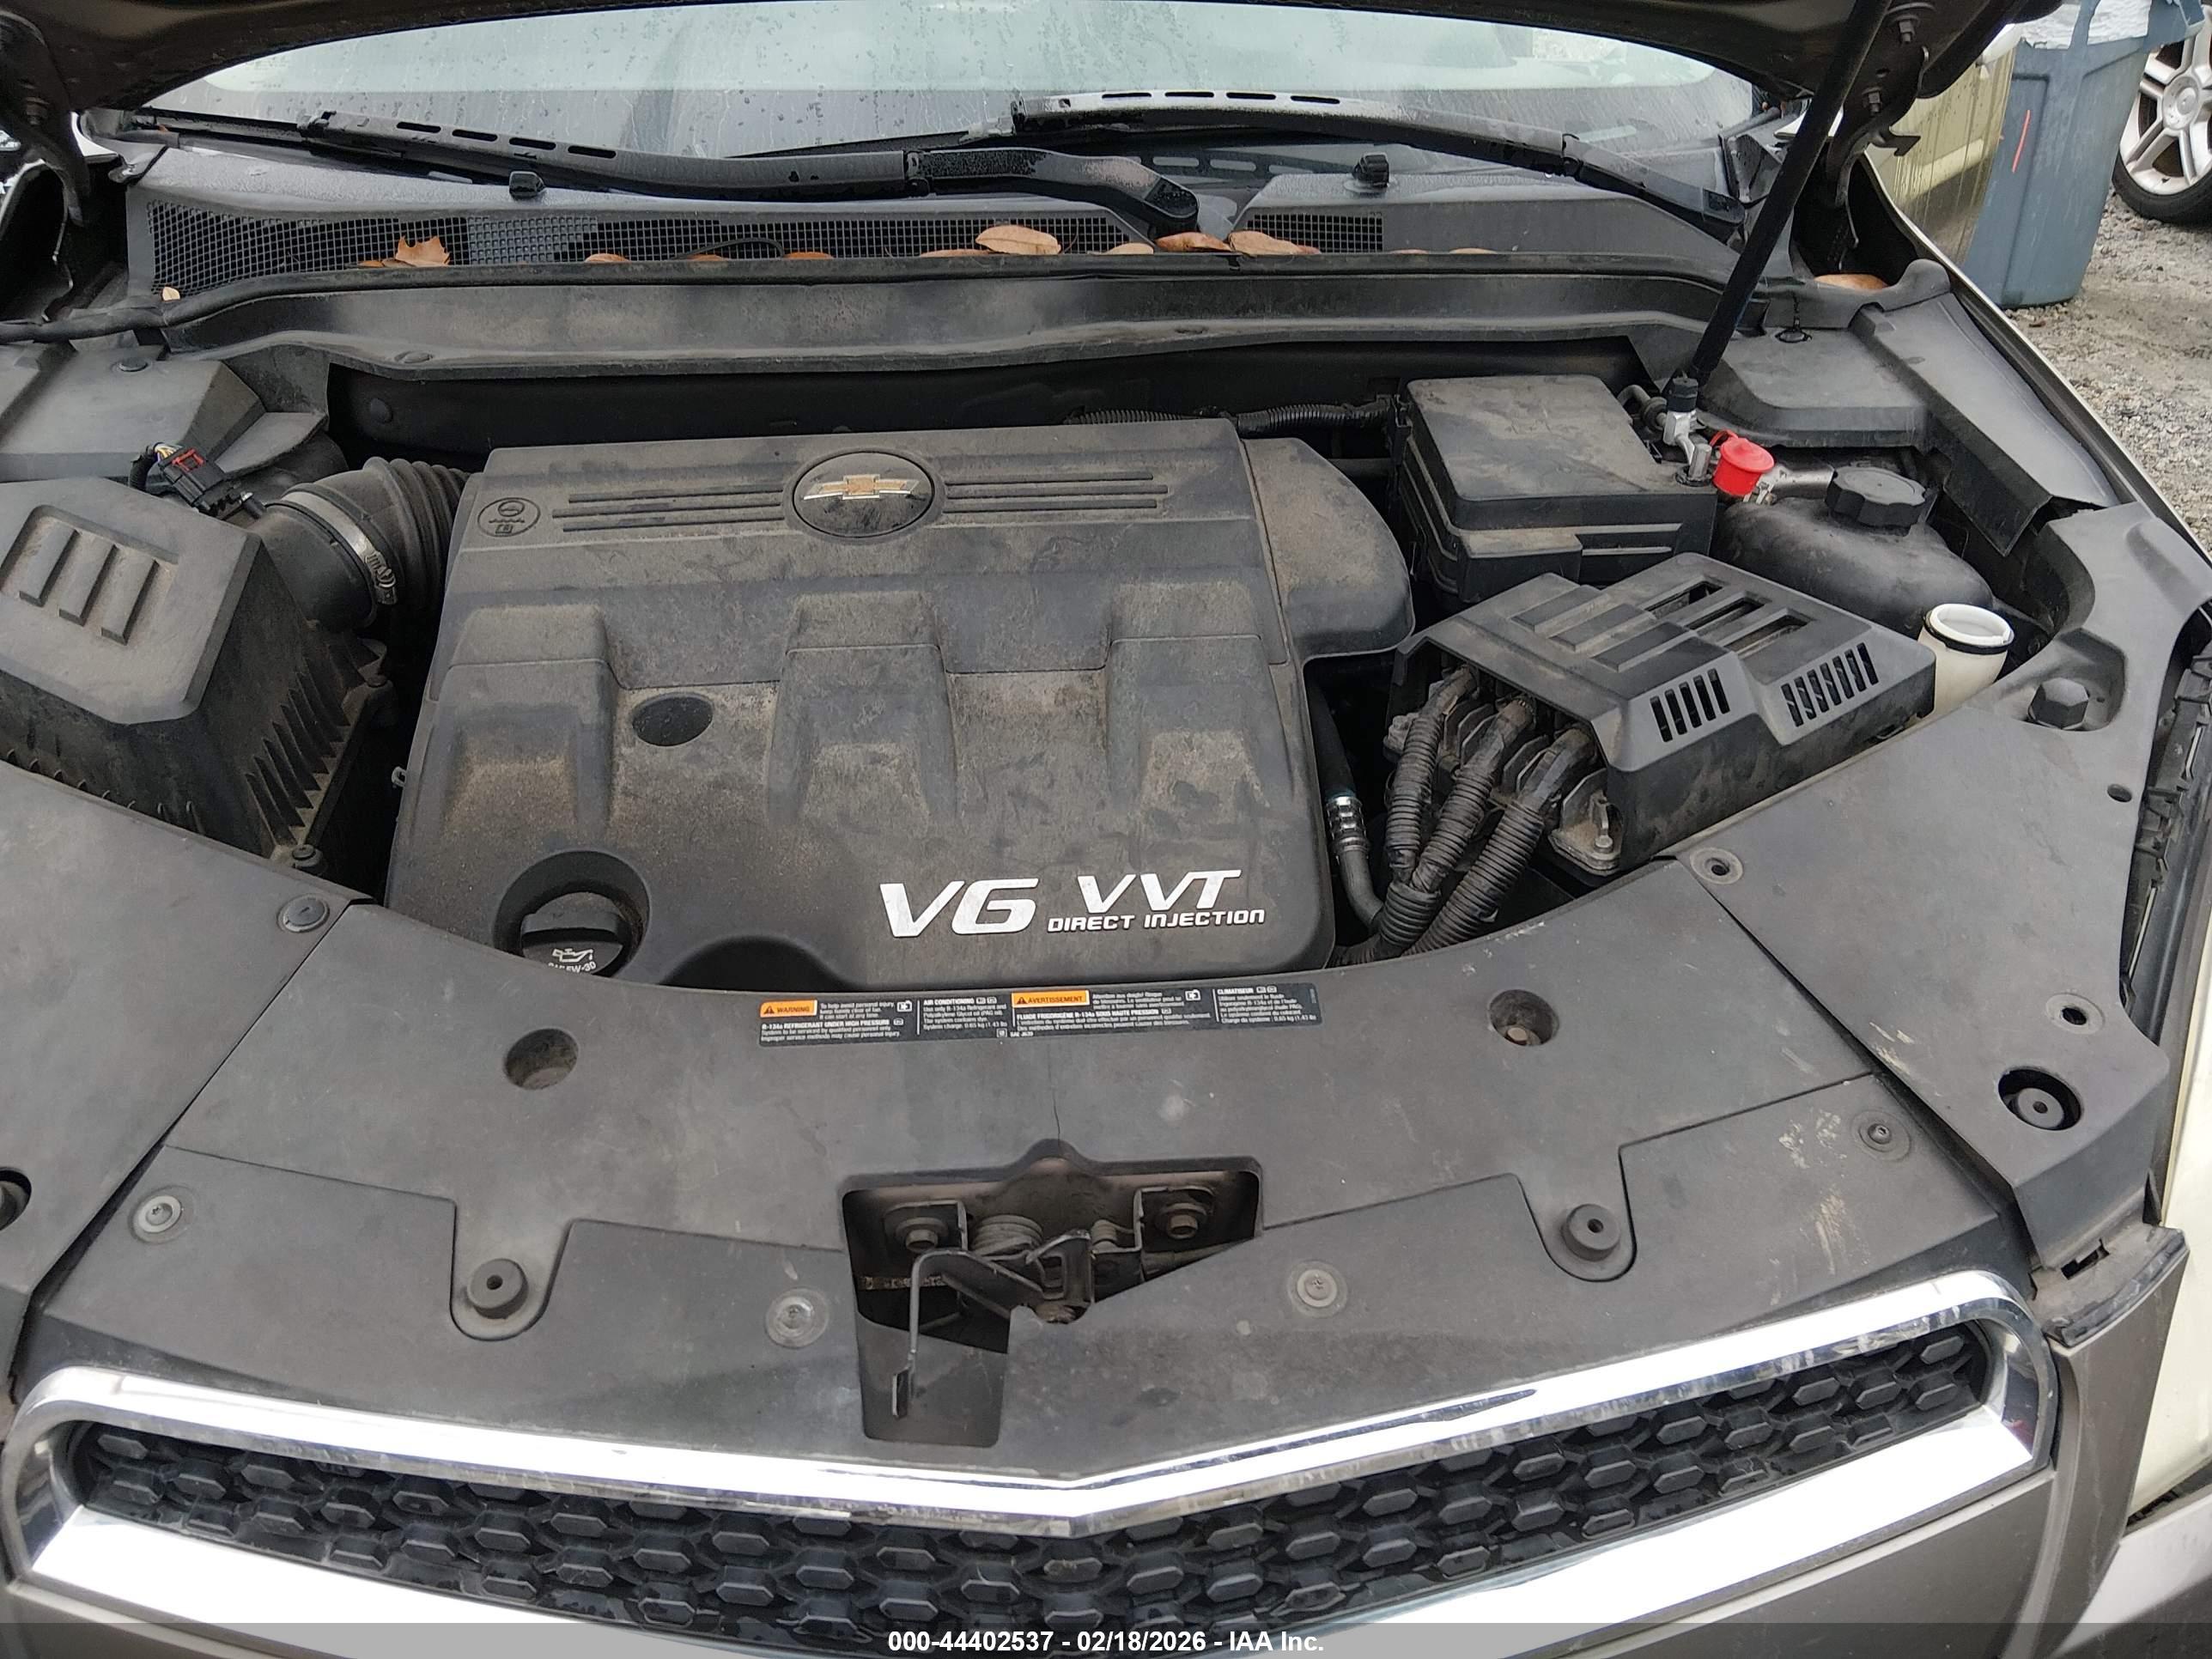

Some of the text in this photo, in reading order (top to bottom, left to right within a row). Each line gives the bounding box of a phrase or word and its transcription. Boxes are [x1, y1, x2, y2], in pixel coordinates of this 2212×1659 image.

[879, 869, 1243, 938] V6 VVT
[1047, 908, 1266, 933] DIRECT INJECTION
